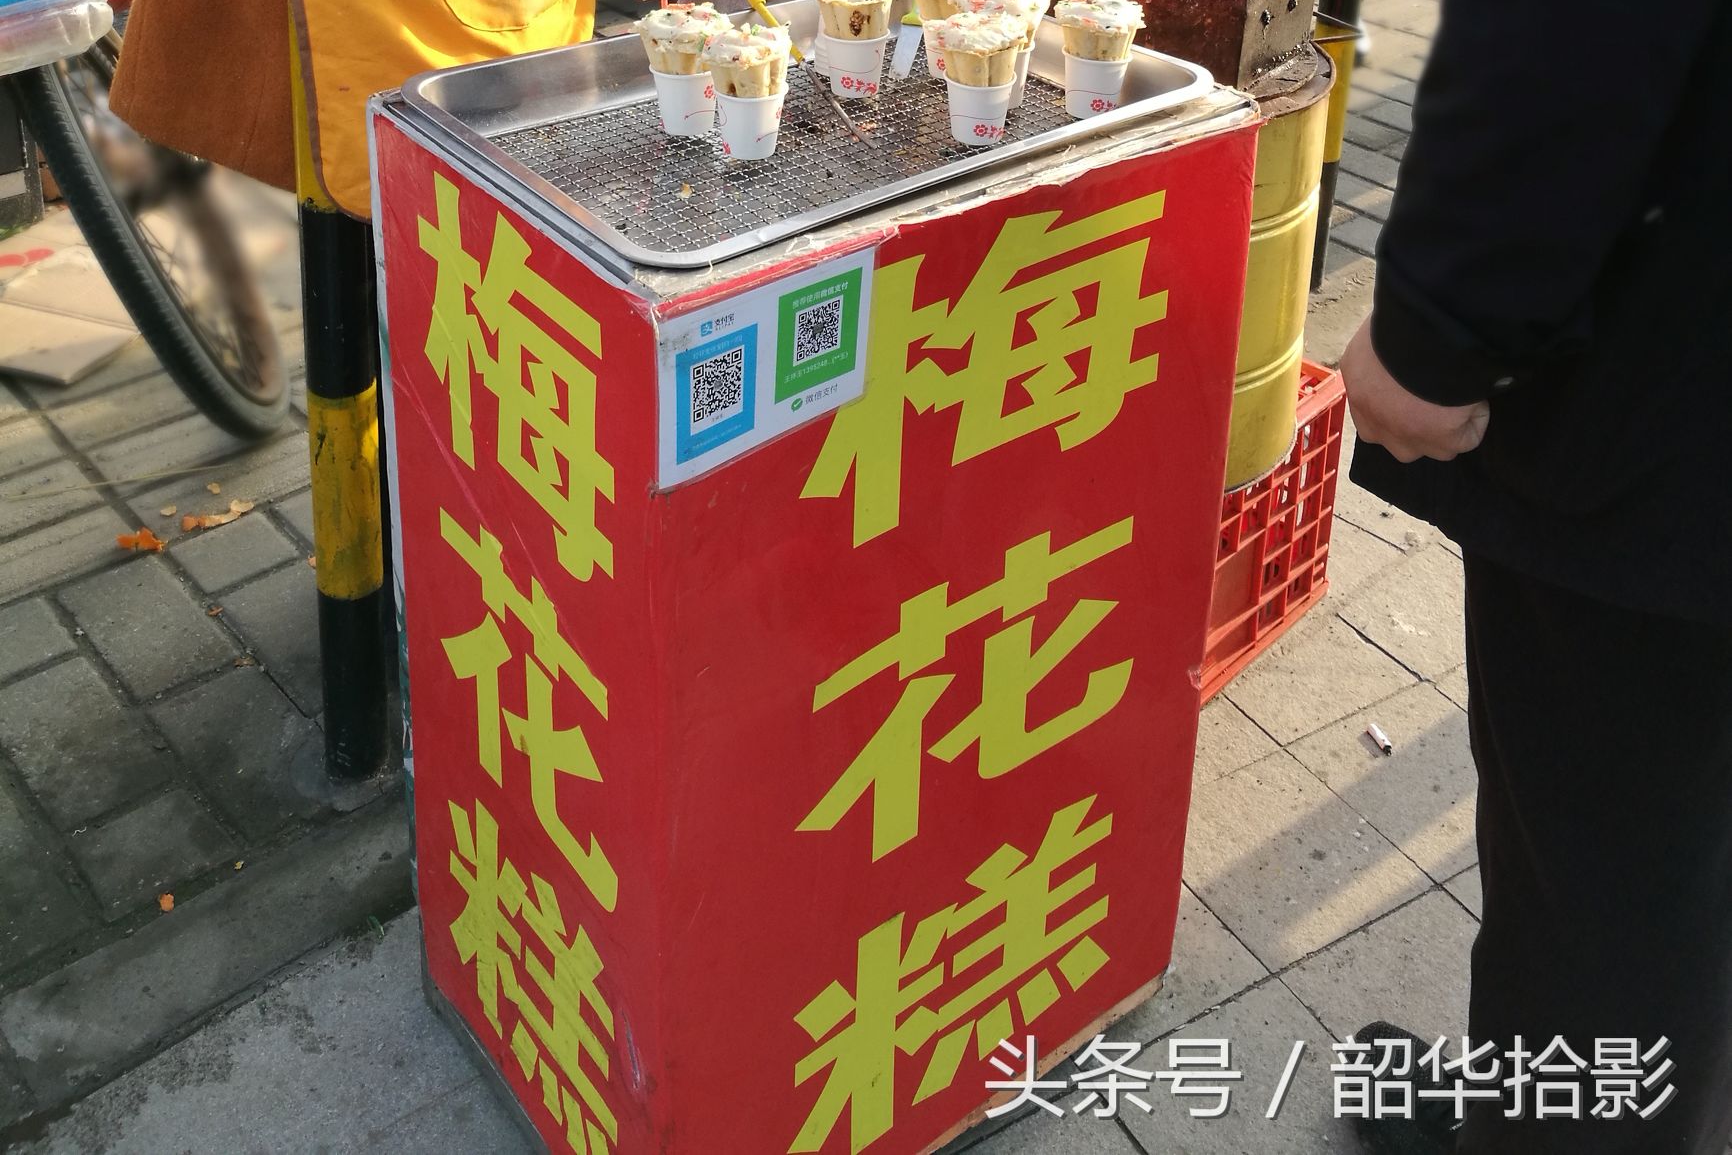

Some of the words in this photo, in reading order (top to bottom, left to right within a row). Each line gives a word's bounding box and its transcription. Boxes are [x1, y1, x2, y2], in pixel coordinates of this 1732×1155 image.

[417, 170, 619, 1155] 梅花糕
[785, 189, 1169, 1155] 梅花糕
[804, 383, 839, 405] 微信支付
